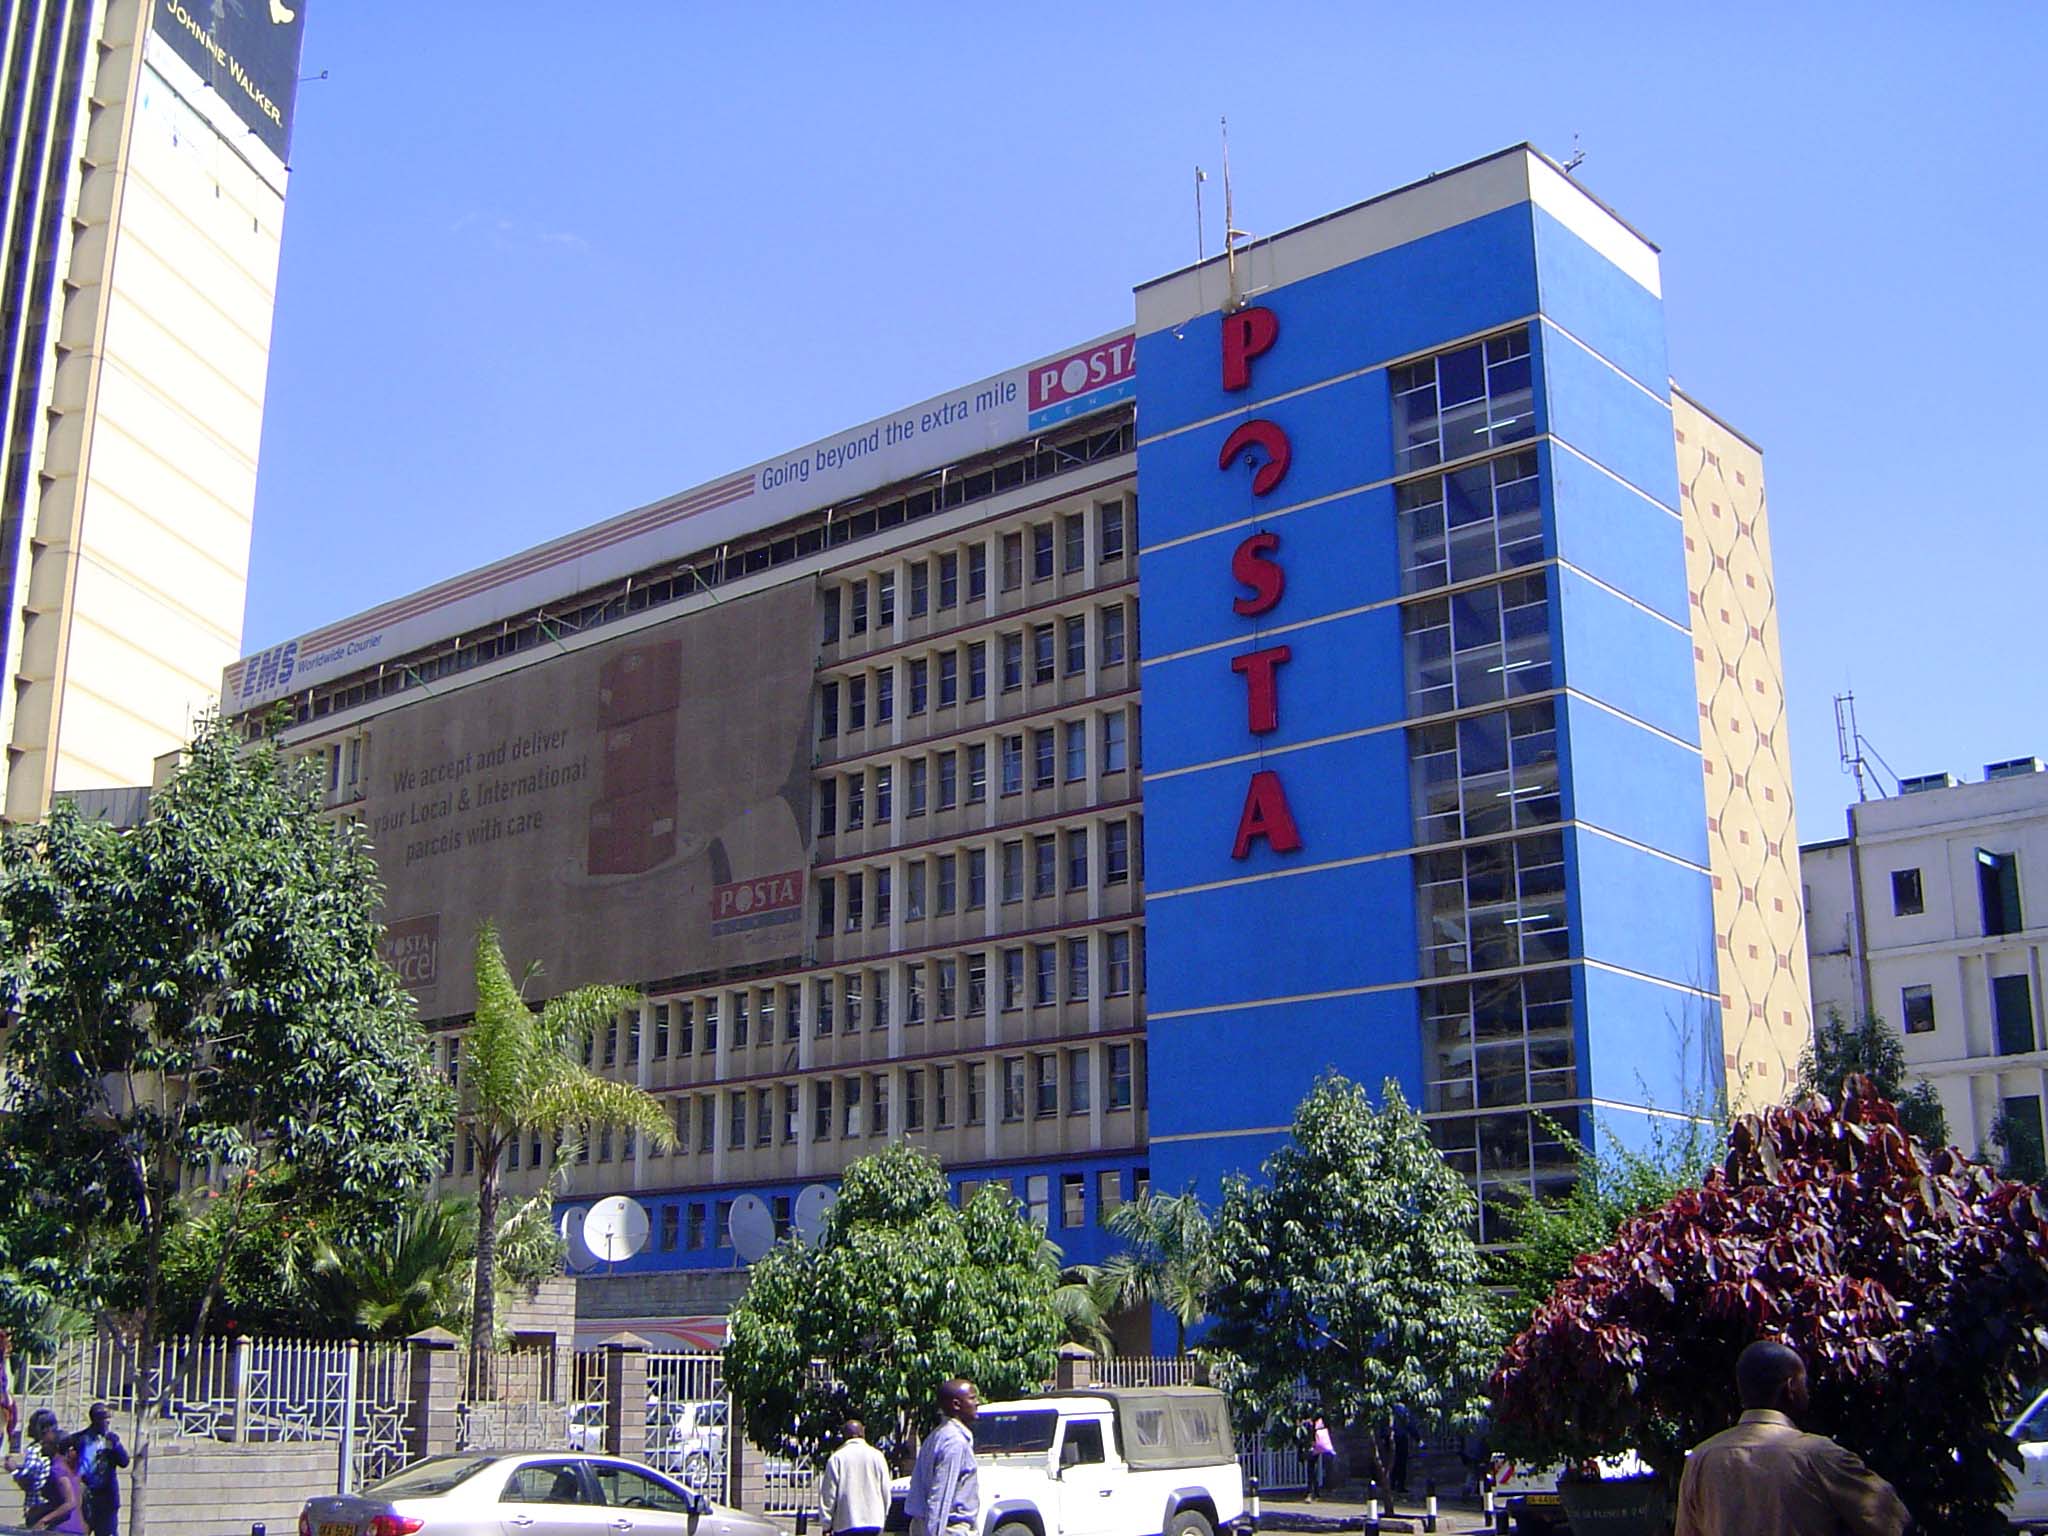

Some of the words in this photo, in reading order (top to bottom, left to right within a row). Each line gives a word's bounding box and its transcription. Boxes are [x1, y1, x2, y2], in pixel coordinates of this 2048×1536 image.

[762, 458, 809, 490] Going
[816, 427, 879, 471] beyond
[886, 421, 914, 446] the
[921, 400, 968, 432] extra
[976, 381, 1016, 412] mile
[242, 641, 297, 698] EMS
[298, 646, 344, 673] Worldwide
[347, 635, 383, 656] Courier
[394, 769, 415, 793] We
[421, 752, 472, 787] accept
[477, 743, 506, 770] and
[512, 729, 567, 759] deliver
[373, 811, 406, 836] your
[410, 792, 452, 825] Local
[458, 788, 470, 812] &
[476, 755, 588, 809] International
[406, 829, 462, 866] parcels
[467, 817, 501, 845] with
[507, 810, 543, 836] care
[721, 879, 793, 914] POSTA
[389, 941, 436, 980] rcel
